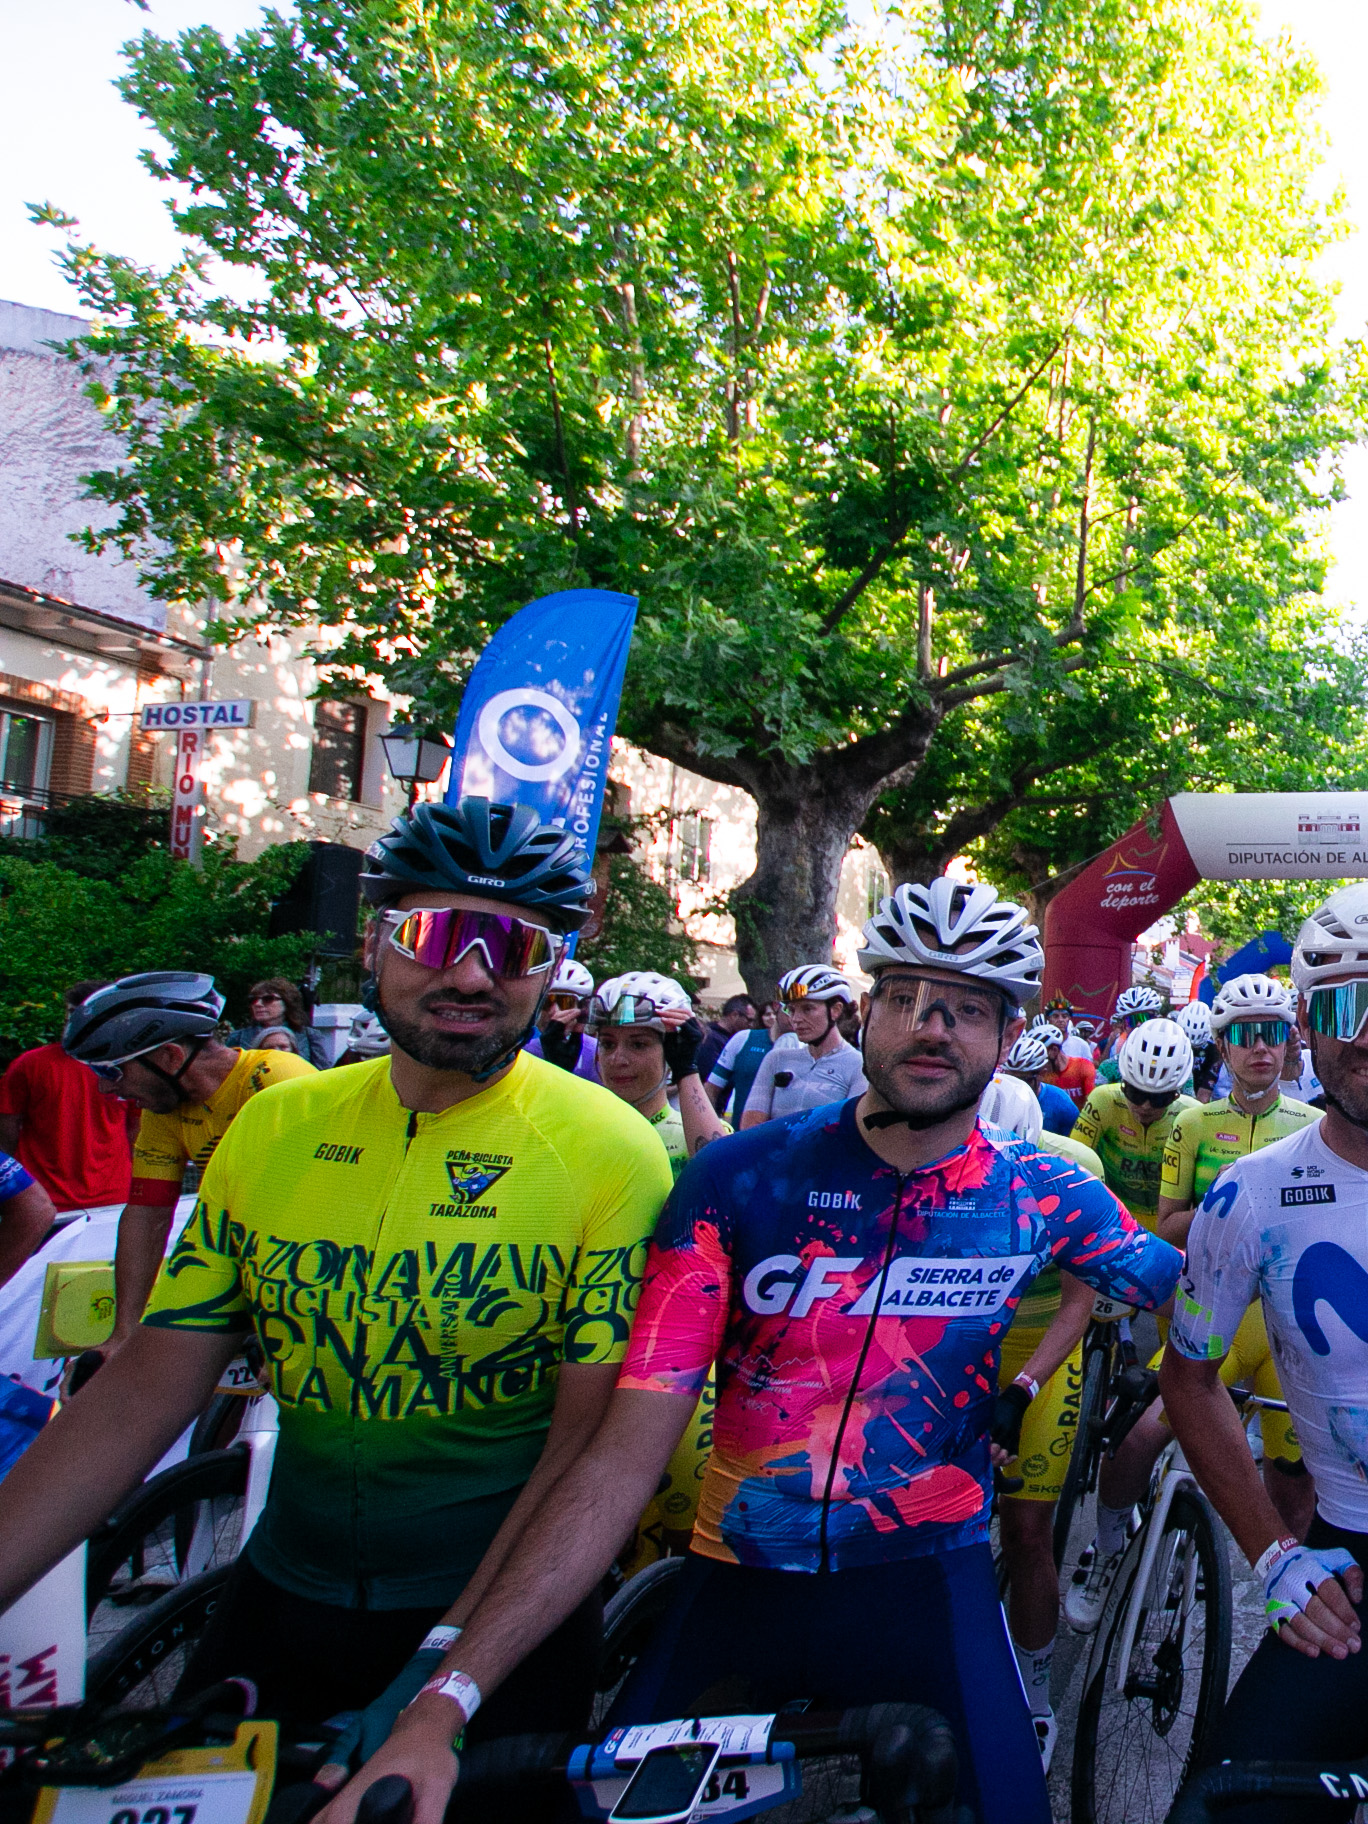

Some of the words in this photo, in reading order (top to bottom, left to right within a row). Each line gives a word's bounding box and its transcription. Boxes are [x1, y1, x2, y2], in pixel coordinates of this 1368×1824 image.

[145, 705, 243, 726] HOSTAL
[179, 732, 198, 795] RIO
[1228, 849, 1321, 864] DIPUTACIÓN
[1326, 851, 1347, 864] DE
[467, 875, 506, 888] GIRO
[1106, 882, 1133, 894] con
[1139, 877, 1155, 892] el
[1101, 893, 1159, 911] deporte
[313, 1143, 365, 1165] GOBIK
[446, 1150, 472, 1162] PEÑA
[473, 1152, 514, 1166] BICLISTA
[808, 1191, 862, 1210] GOBIK
[1285, 1187, 1330, 1202] GOBIK
[430, 1203, 498, 1219] TARAZONA
[907, 1267, 982, 1285] SIERRA
[988, 1265, 1015, 1283] de
[883, 1289, 1001, 1307] ALBACETE
[1095, 1300, 1113, 1314] 26
